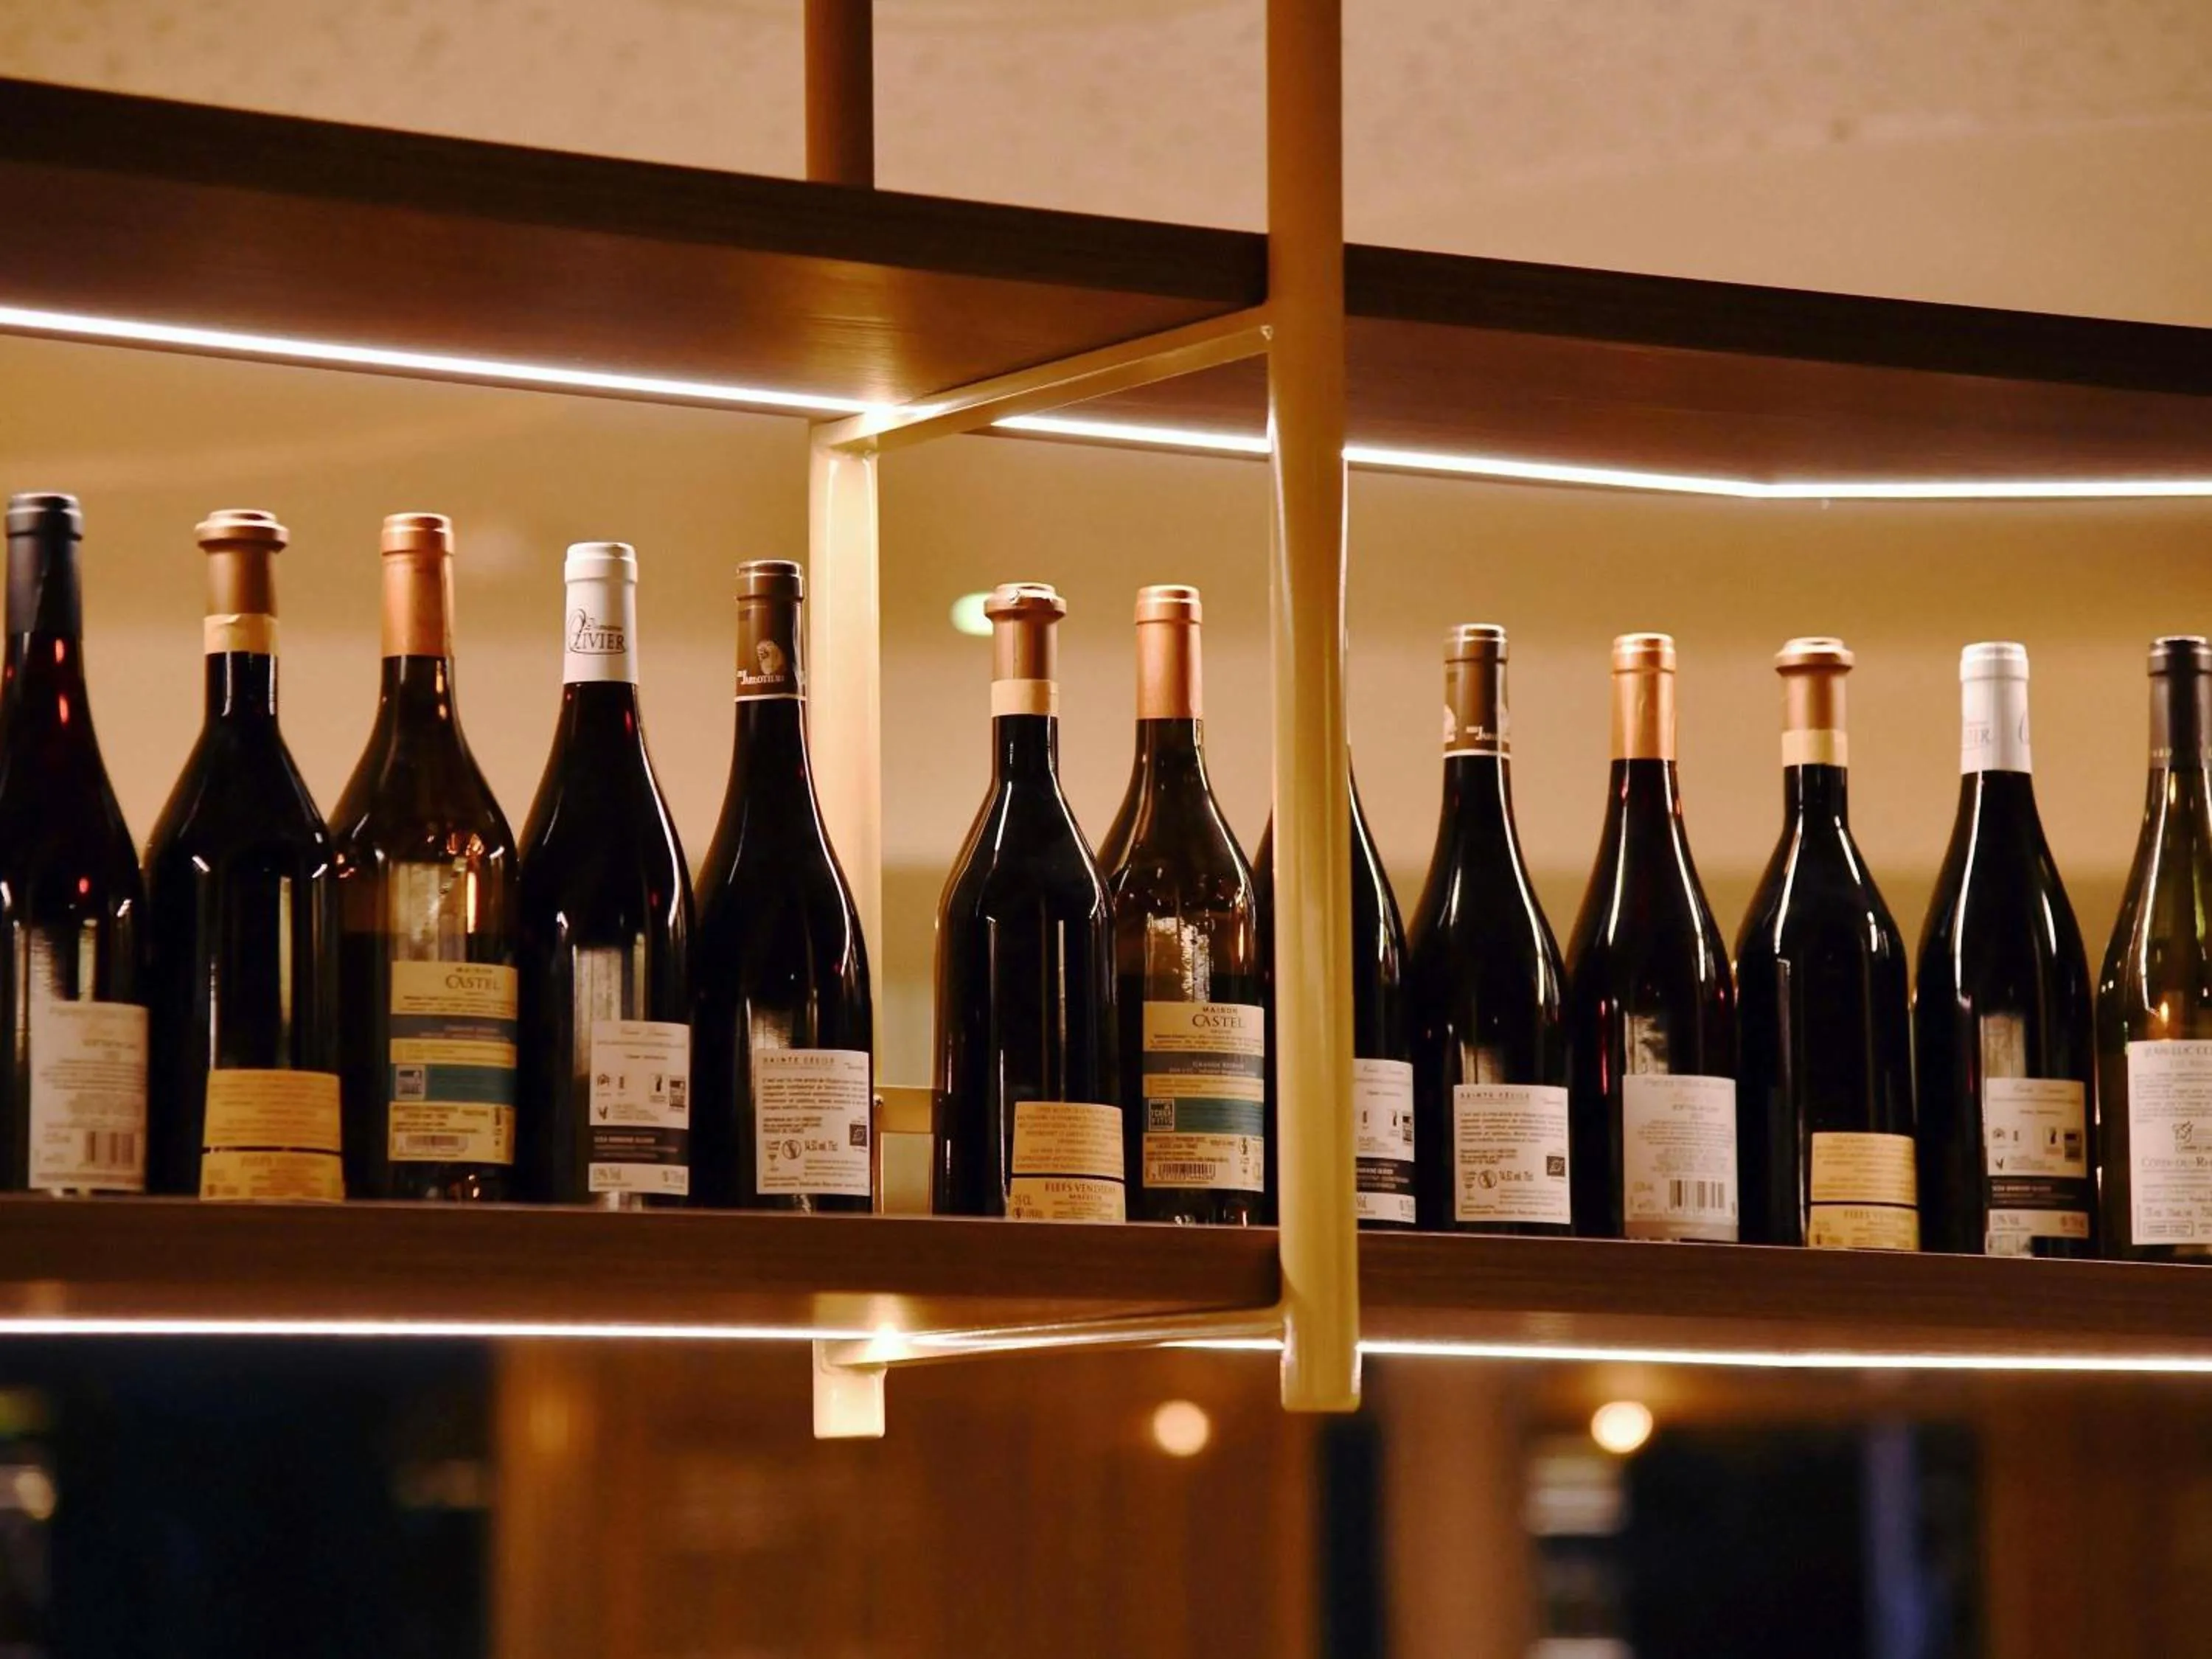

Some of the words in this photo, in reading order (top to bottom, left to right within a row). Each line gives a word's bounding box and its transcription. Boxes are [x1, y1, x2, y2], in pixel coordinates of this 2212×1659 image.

[445, 974, 501, 991] CASTEL
[1203, 1006, 1238, 1014] MAISON
[1192, 1014, 1246, 1028] CASTEL
